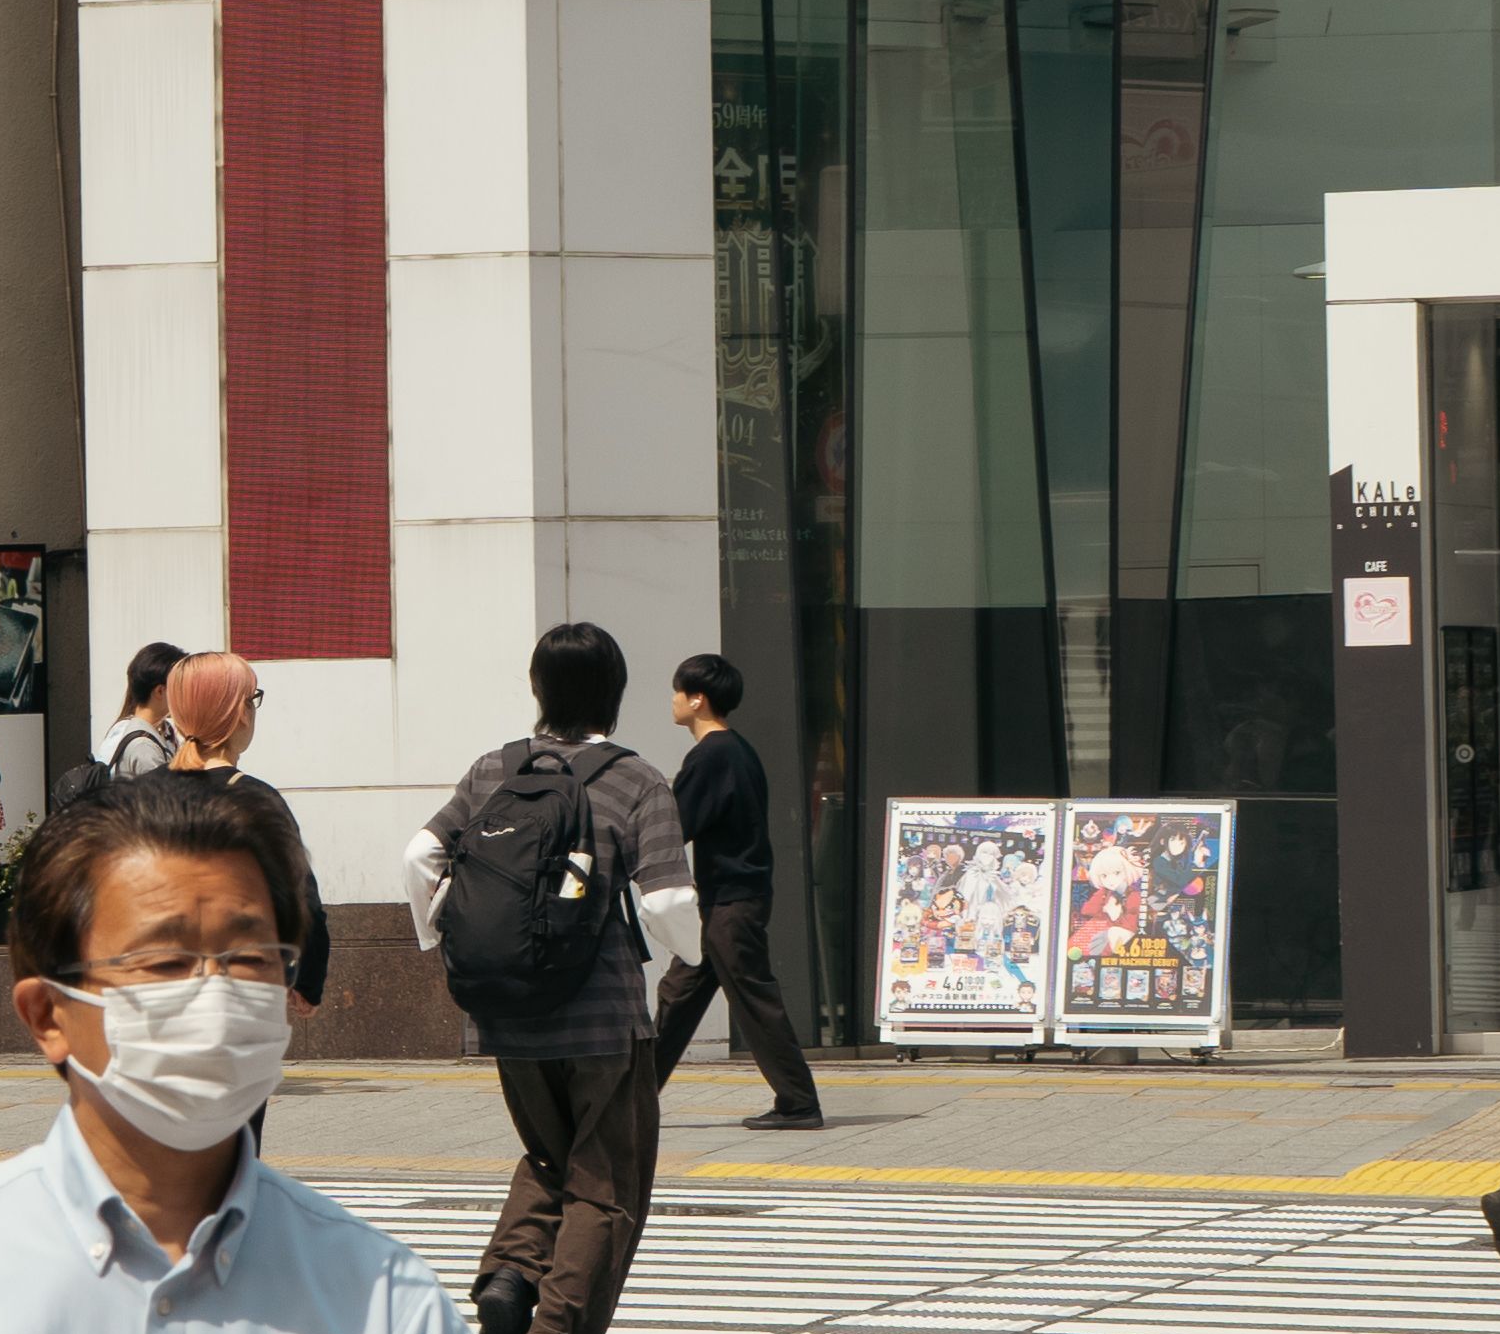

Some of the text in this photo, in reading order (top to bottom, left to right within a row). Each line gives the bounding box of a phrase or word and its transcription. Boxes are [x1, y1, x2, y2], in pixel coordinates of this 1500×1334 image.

[1356, 481, 1416, 502] KALe
[1356, 505, 1416, 518] CHIKA
[1365, 561, 1388, 572] CAFE
[1116, 938, 1167, 958] 4.6 10:00
[1101, 958, 1118, 967] NEW
[1120, 957, 1151, 967] MACHINE
[942, 976, 985, 992] 4.6 10:00
